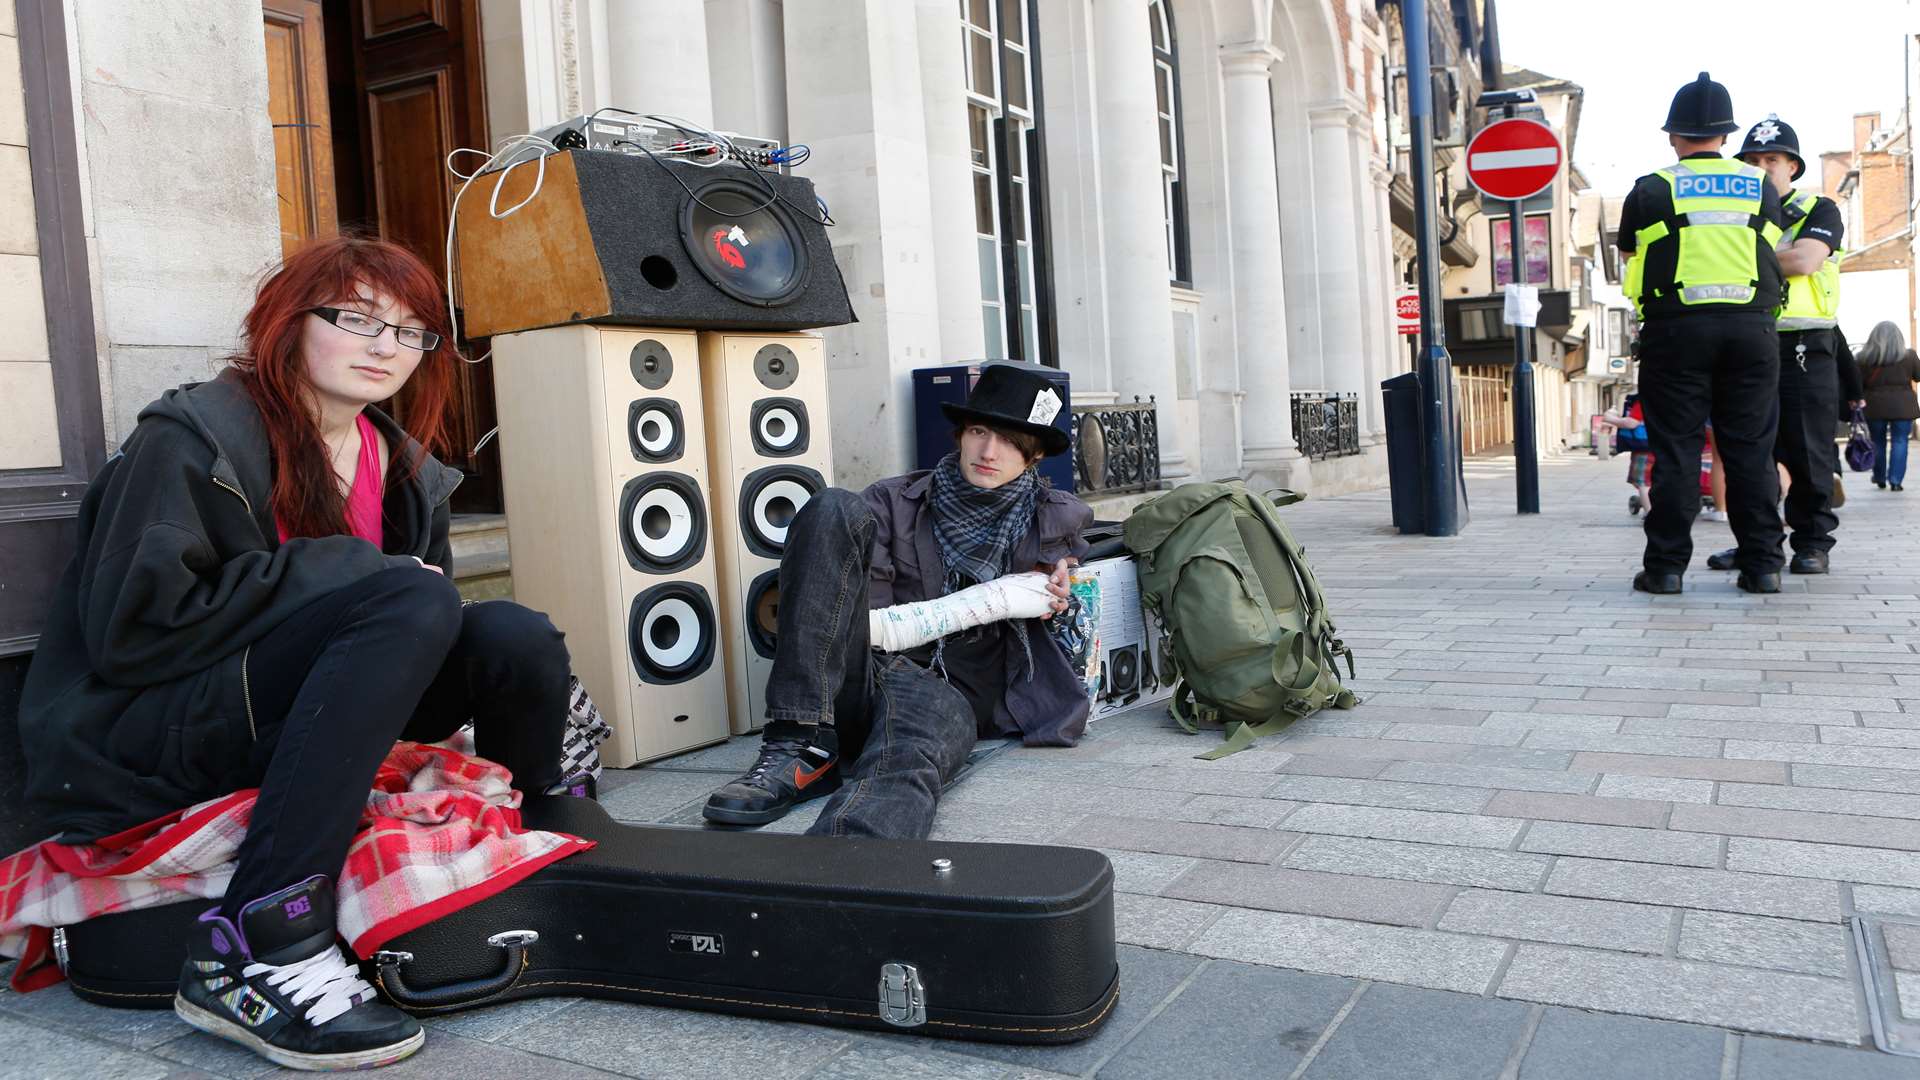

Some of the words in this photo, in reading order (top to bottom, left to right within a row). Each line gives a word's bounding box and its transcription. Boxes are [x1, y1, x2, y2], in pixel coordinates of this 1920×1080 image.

[1679, 177, 1758, 197] POLICE
[1400, 299, 1420, 307] POS
[1397, 306, 1420, 314] OFFIC
[692, 935, 720, 953] TGI
